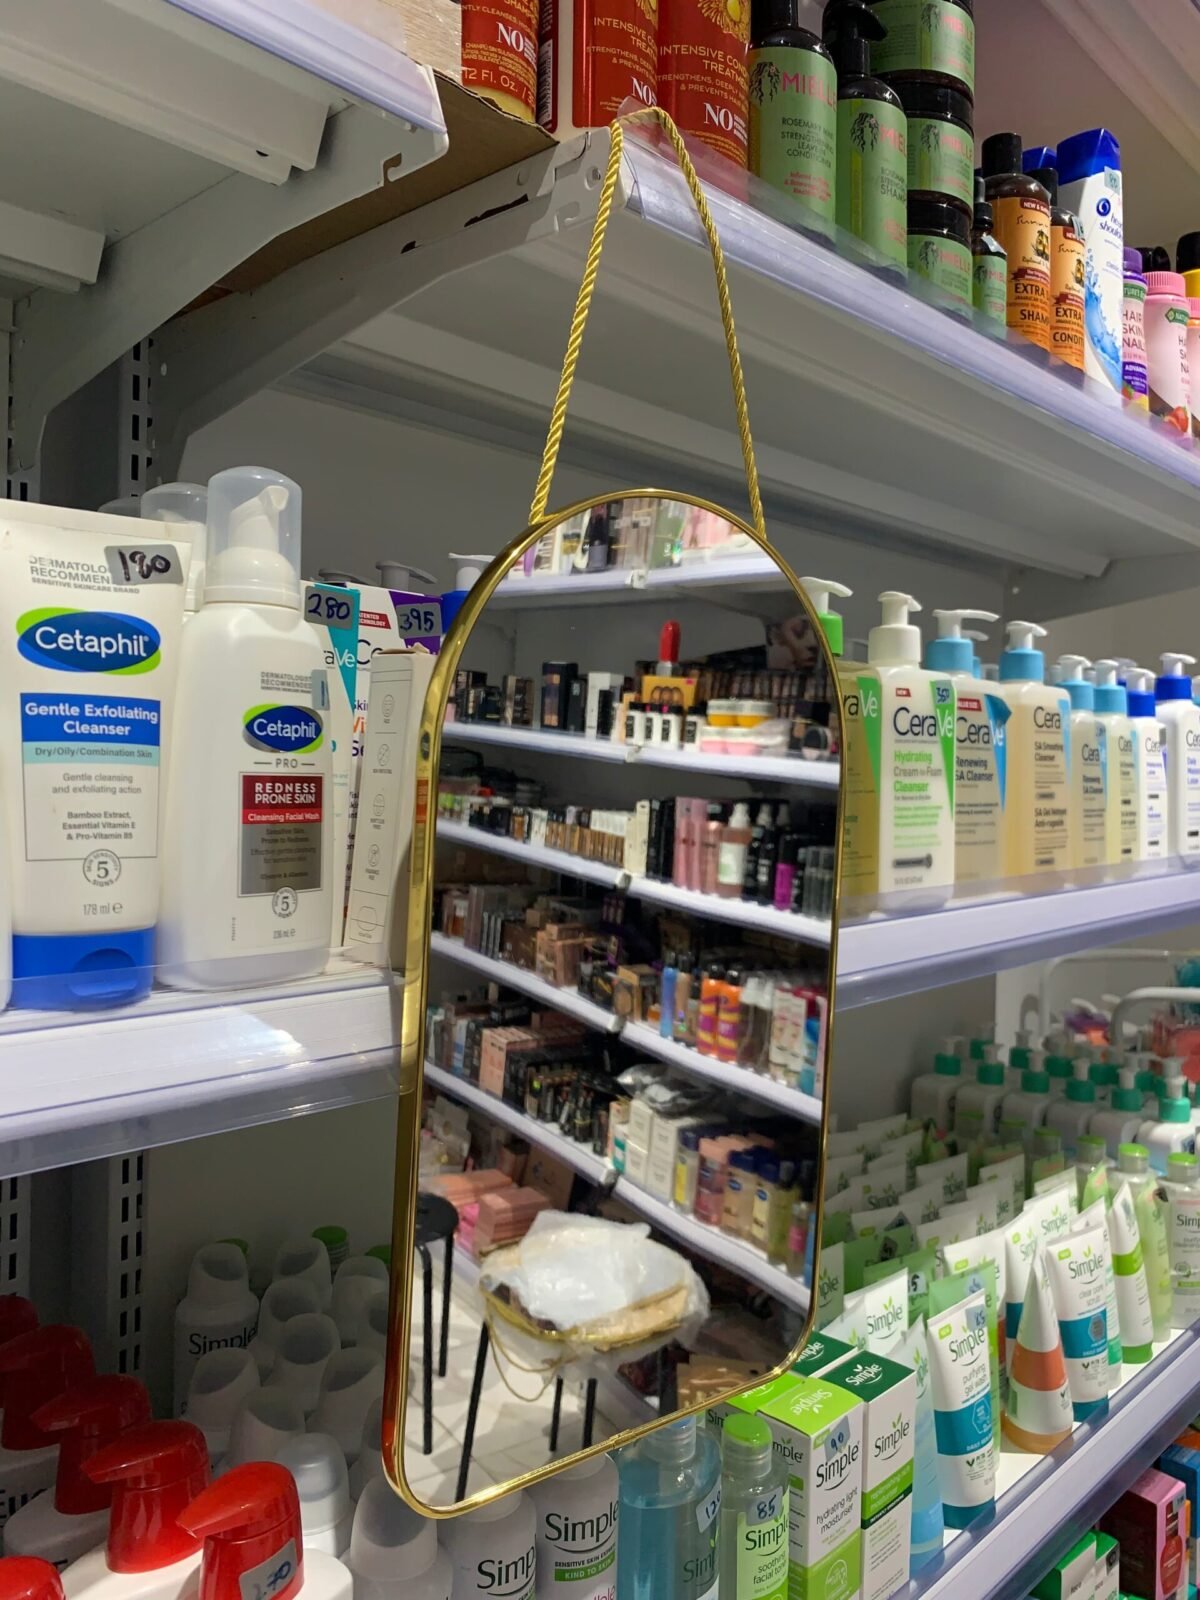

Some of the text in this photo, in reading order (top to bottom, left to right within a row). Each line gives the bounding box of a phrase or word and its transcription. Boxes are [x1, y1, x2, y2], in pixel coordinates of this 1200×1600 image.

[496, 21, 524, 52] NO
[593, 16, 646, 41] INTENSIVE
[659, 44, 725, 62] INTENSIVE
[464, 67, 478, 79] 12
[500, 75, 518, 92] Oz.
[656, 73, 714, 84] TRENGTHENS,
[631, 76, 652, 105] NO
[688, 83, 729, 100] PREVENTS
[703, 102, 733, 131] NO
[782, 117, 822, 131] ROSEMARY
[1023, 201, 1037, 210] NEW
[1014, 282, 1045, 298] EXTRA
[1055, 307, 1082, 320] EXTRA
[31, 576, 141, 595] SENSITIVE SKINCARE BRAND
[307, 592, 351, 621] 280
[400, 607, 434, 633] 395
[35, 626, 147, 658] Cetaphil
[24, 702, 159, 724] Gentle Exfoliating
[893, 706, 954, 738] CeraVe
[63, 721, 131, 736] Cleanser
[253, 718, 316, 741] Cetaphil
[35, 747, 152, 758] Dry/Oily/Combination Skin
[893, 751, 933, 764] Hydrating
[1034, 753, 1056, 763] Cleanser
[275, 758, 298, 769] PRO
[62, 772, 133, 784] Gentle cleansing
[966, 770, 994, 782] Cleanser
[52, 784, 142, 796] and exfoliating action
[255, 783, 316, 793] REDNESS
[893, 780, 929, 792] Cleanser
[255, 793, 316, 804] PRONE SKIN
[67, 811, 102, 820] Bamboo
[247, 812, 320, 823] Cleansing Facial Wash
[62, 821, 136, 831] Essential Vitamin E
[66, 832, 73, 841] &
[75, 832, 122, 842] Pro-Vitamin
[96, 860, 110, 880] 5
[91, 878, 115, 888] SIGNS
[82, 902, 110, 916] 178 ml
[280, 895, 290, 913] 5
[1040, 1213, 1068, 1236] Simple
[1068, 1254, 1104, 1280] Simple
[866, 1306, 903, 1336] Simple
[949, 1328, 986, 1363] Simple
[845, 1363, 882, 1386] Simple
[962, 1362, 987, 1386] purifying
[964, 1384, 975, 1398] gel
[790, 1388, 833, 1416] Simple
[874, 1421, 910, 1459] Simple
[815, 1444, 860, 1489] Simple
[756, 1494, 777, 1520] 85
[816, 1498, 845, 1525] hydrating
[845, 1486, 858, 1504] light
[820, 1502, 854, 1535] moisturiser
[555, 1554, 600, 1568] SENSITIVE SKIN
[565, 1557, 613, 1579] KIND TO SKIN
[752, 1568, 774, 1586] facial
